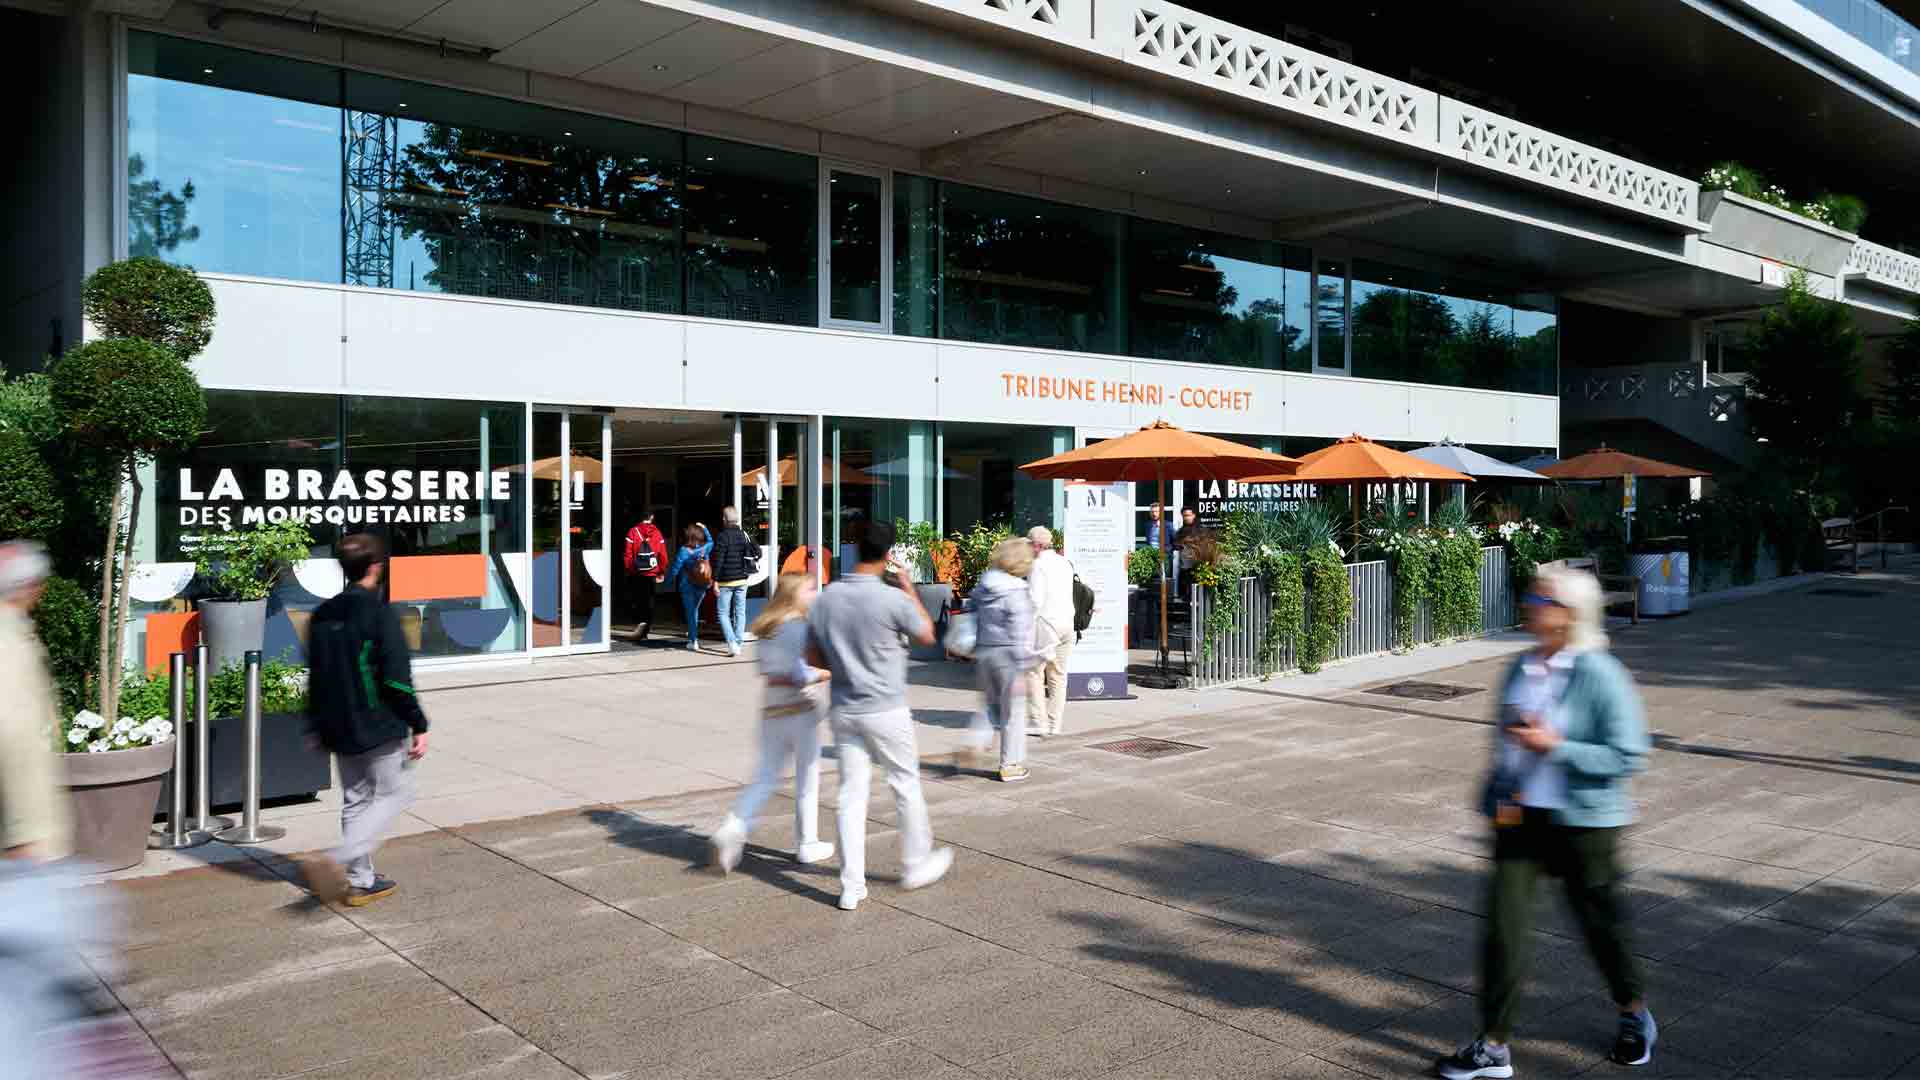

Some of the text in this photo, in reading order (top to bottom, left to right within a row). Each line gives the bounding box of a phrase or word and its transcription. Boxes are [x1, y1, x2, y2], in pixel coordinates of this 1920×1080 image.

[1001, 373, 1096, 401] TRIBUNE
[1103, 381, 1164, 405] HENRI
[1180, 387, 1253, 411] COCHET
[179, 467, 511, 500] LA BRASSERIE
[1199, 479, 1317, 498] LA BRASSERIE
[180, 504, 466, 526] DES MOUSQUETAIRES
[1198, 500, 1218, 513] DES
